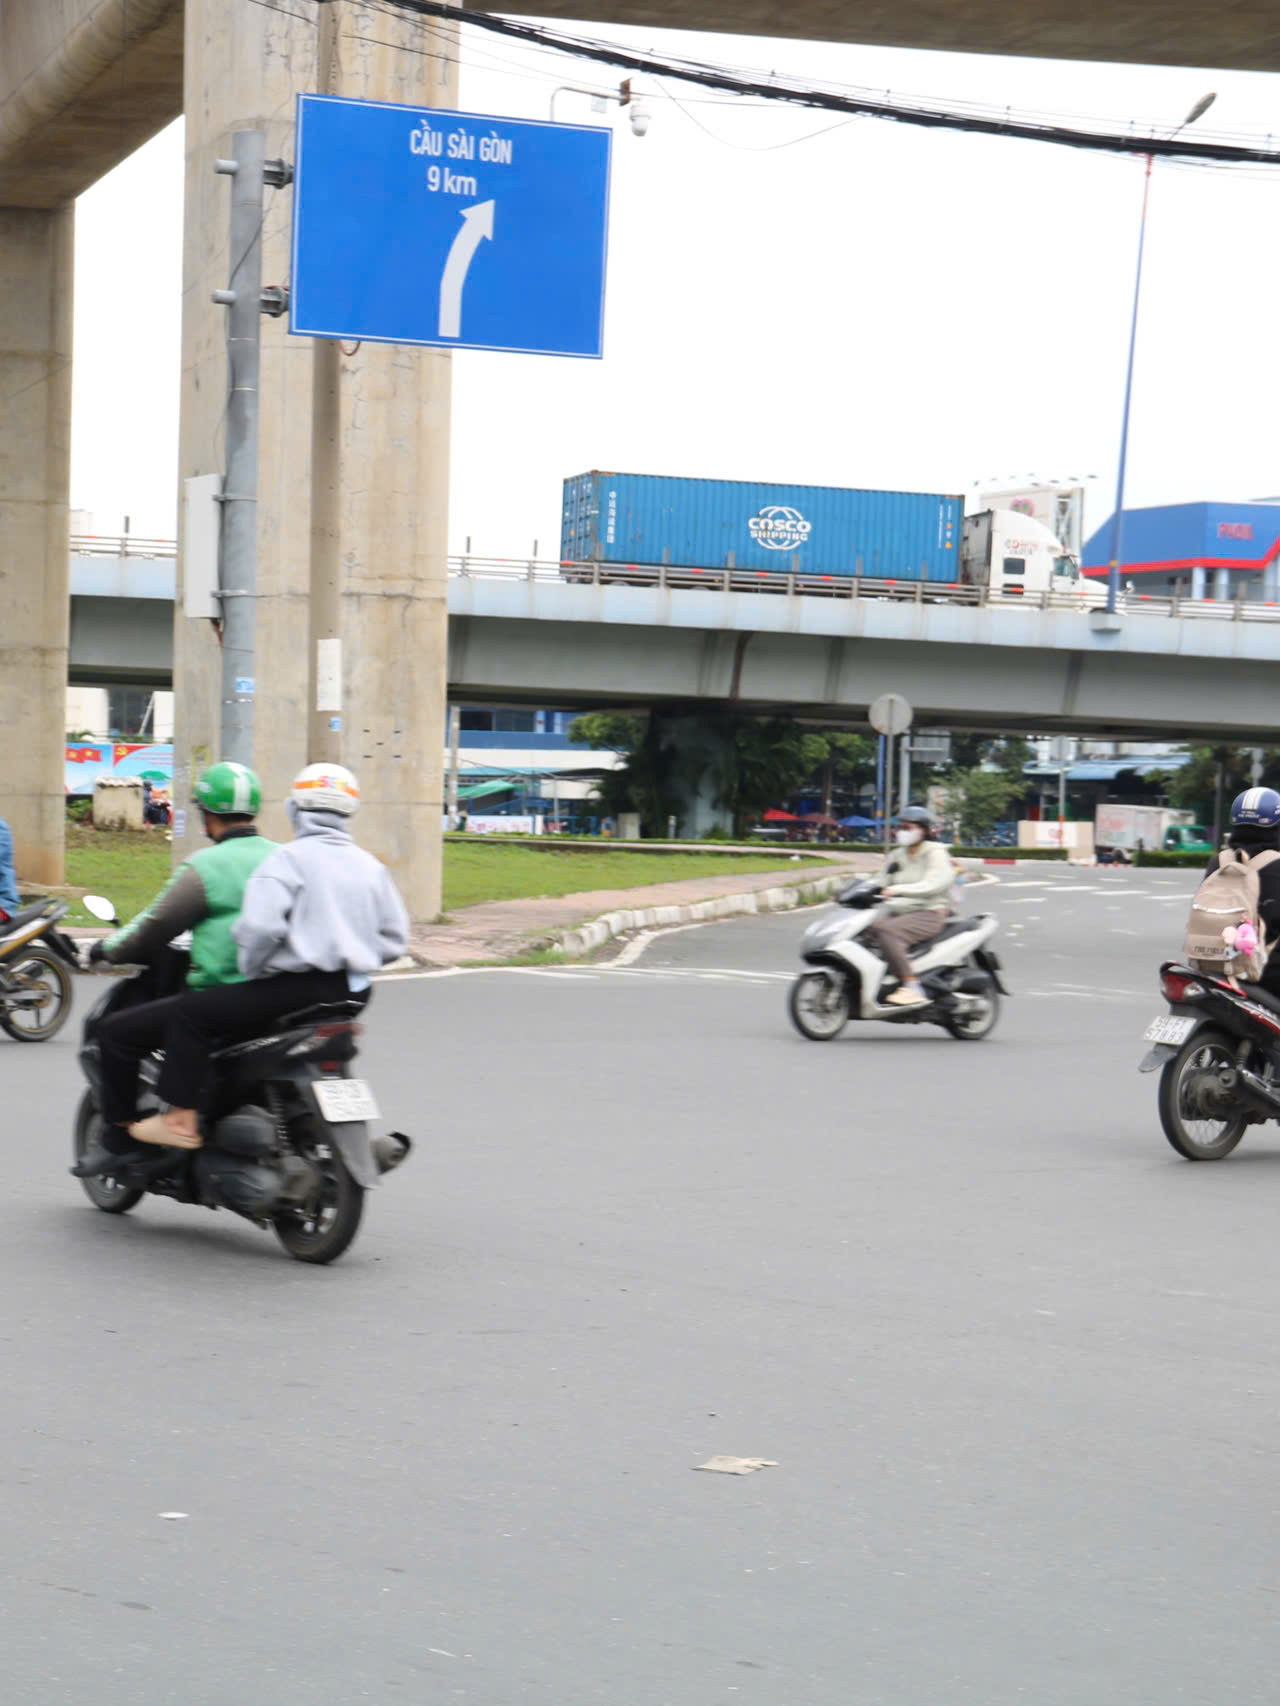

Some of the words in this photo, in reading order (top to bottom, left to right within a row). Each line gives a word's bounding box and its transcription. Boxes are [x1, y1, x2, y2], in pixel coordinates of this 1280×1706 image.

[410, 119, 442, 156] CẦU
[447, 127, 475, 160] SÀI
[480, 130, 513, 164] GÒN
[427, 165, 440, 192] 9
[443, 167, 477, 196] km
[748, 517, 811, 533] COSCO
[750, 530, 808, 541] SHIPPING
